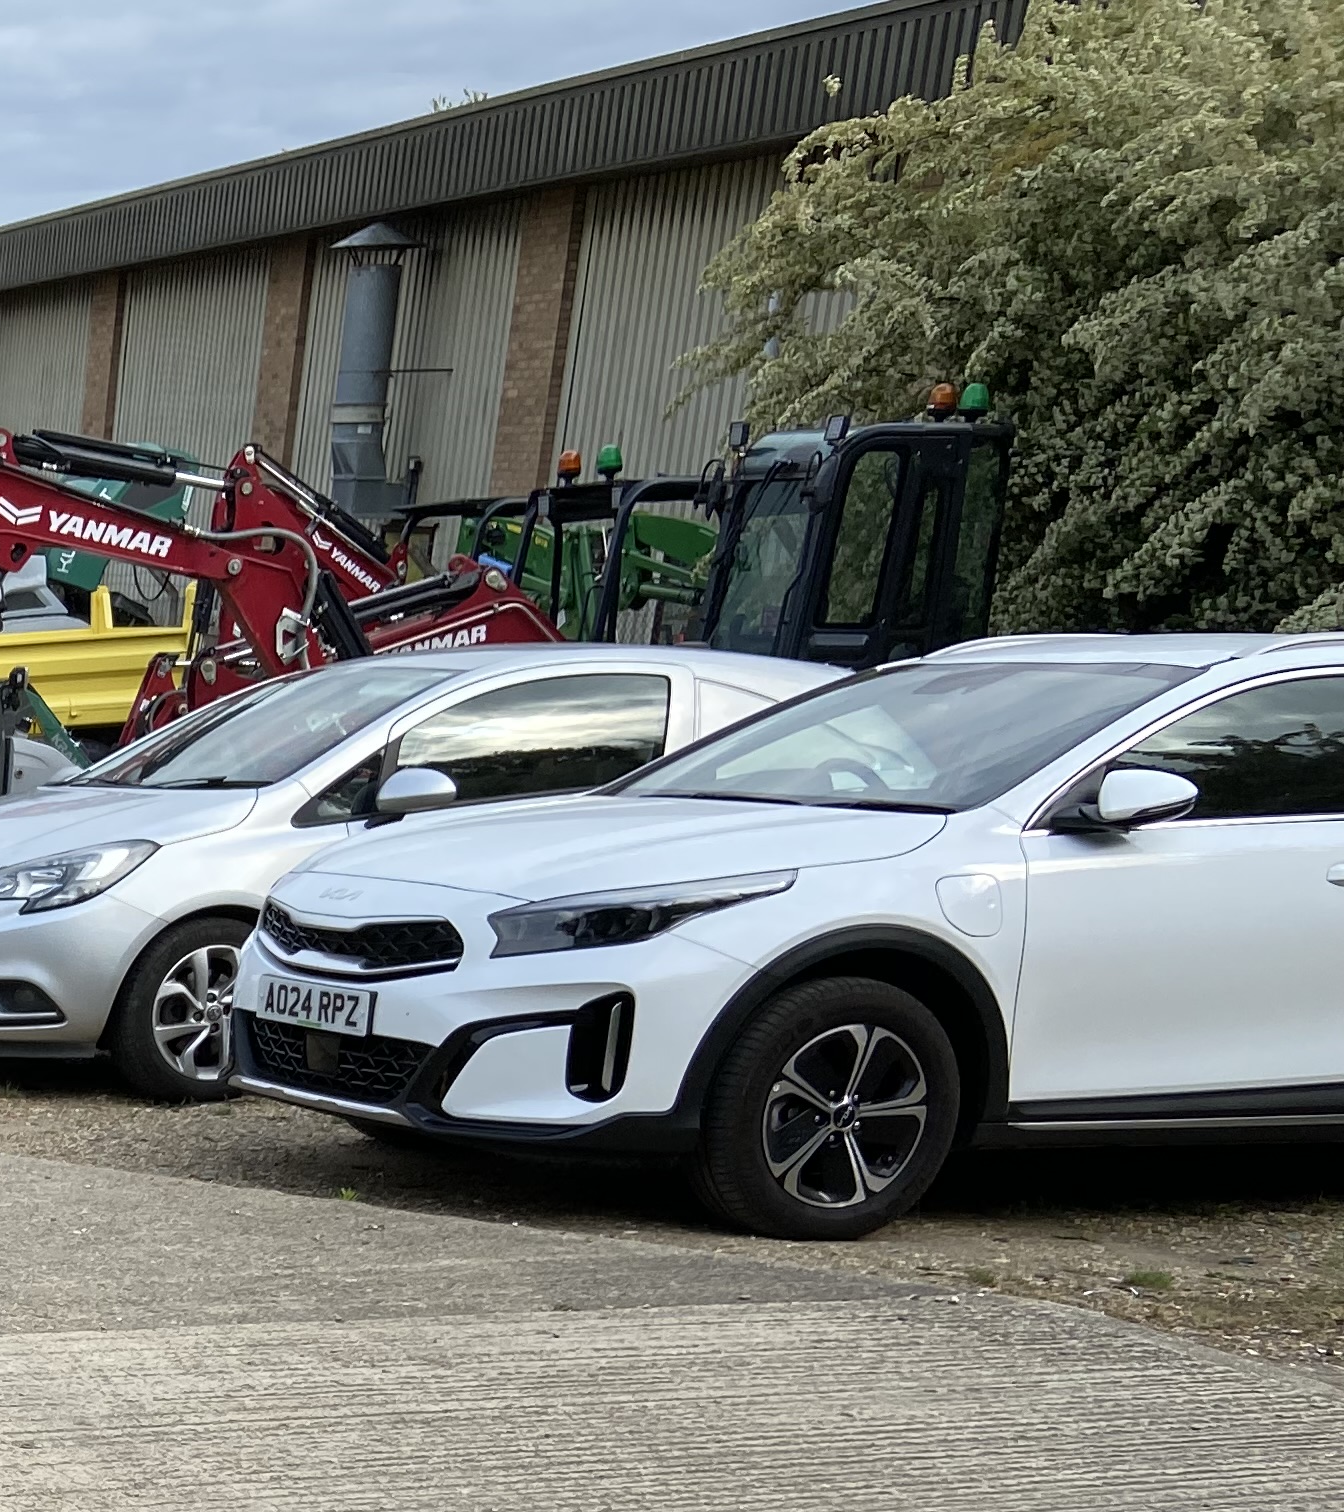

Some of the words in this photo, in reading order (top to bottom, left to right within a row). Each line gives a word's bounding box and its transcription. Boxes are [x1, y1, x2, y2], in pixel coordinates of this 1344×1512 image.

[48, 510, 173, 558] YANMAR
[330, 546, 382, 593] YANMAR
[384, 624, 488, 654] ANMAR
[317, 990, 360, 1028] RPZ
